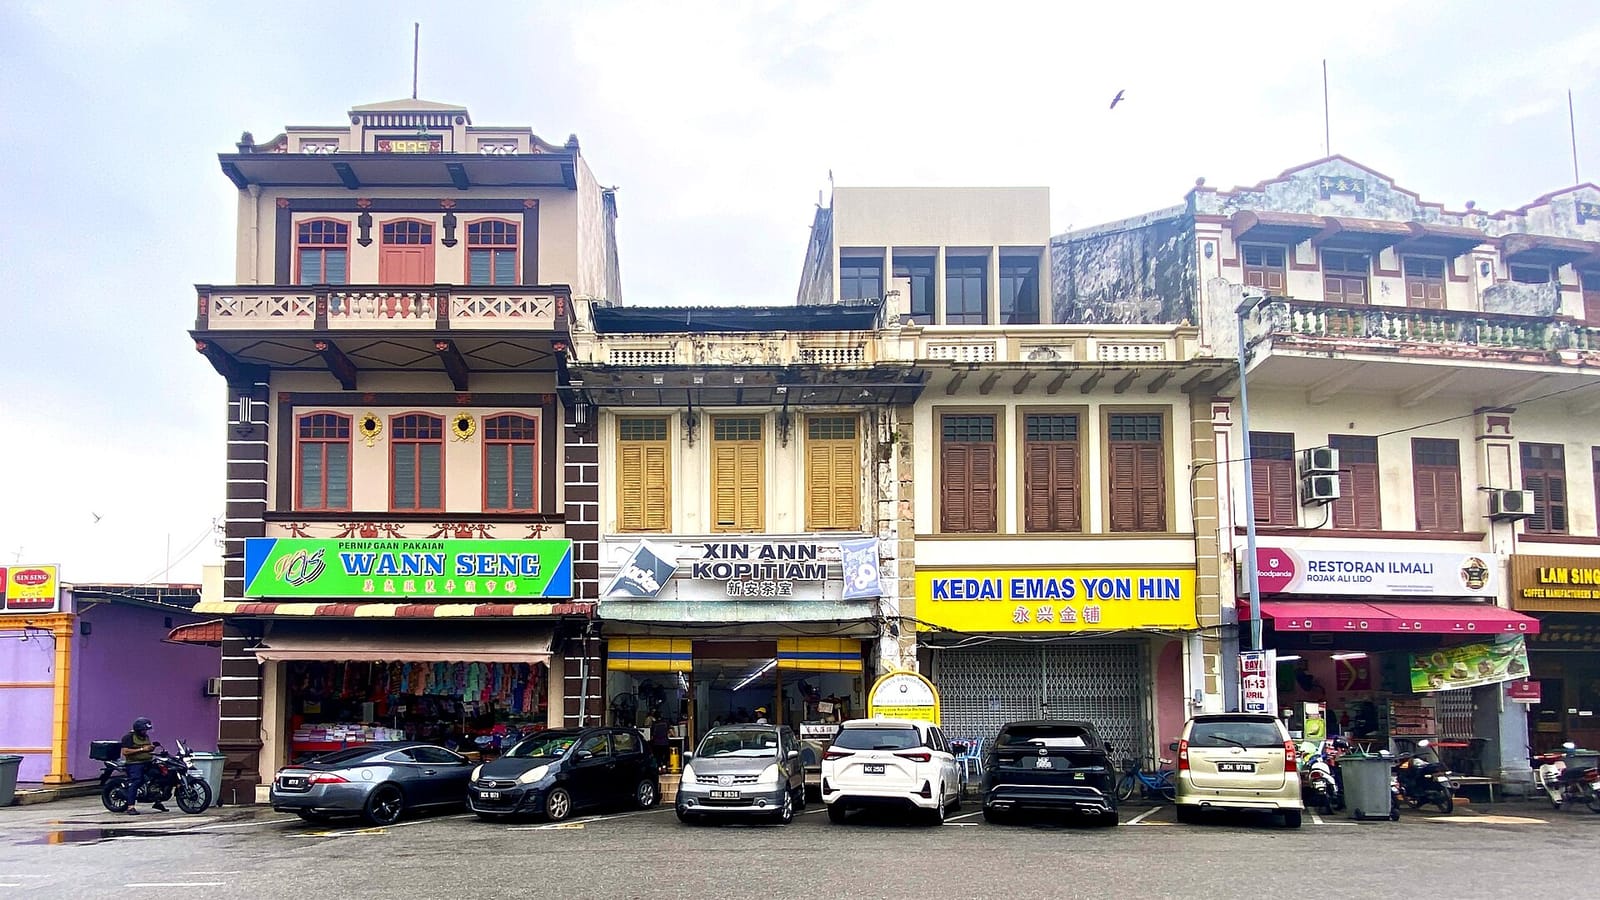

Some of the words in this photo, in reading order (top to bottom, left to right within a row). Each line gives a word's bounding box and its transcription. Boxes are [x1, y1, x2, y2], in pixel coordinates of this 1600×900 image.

[391, 141, 428, 152] 1935
[339, 542, 399, 550] PERNIAGAAN
[403, 542, 444, 550] PAKAIAN
[702, 543, 749, 559] XIN
[758, 543, 817, 559] ANN
[340, 553, 446, 575] WANN
[456, 553, 541, 576] SENG
[692, 563, 827, 579] KOPITIAM
[1308, 560, 1384, 573] RESTORAN
[1388, 561, 1433, 574] ILMALI
[1257, 569, 1292, 577] foodpanda
[1306, 574, 1335, 582] ROJAK
[1352, 575, 1373, 583] LIDO
[1540, 566, 1568, 584] LAM
[1571, 568, 1600, 585] SING
[727, 582, 792, 596] 新安茶室
[932, 579, 1002, 599] KEDAI
[1011, 578, 1075, 599] EMAS
[1082, 578, 1131, 599] YON
[1139, 578, 1180, 599] HIN
[1523, 588, 1545, 598] COFFEE
[1014, 606, 1100, 623] 永兴金铺
